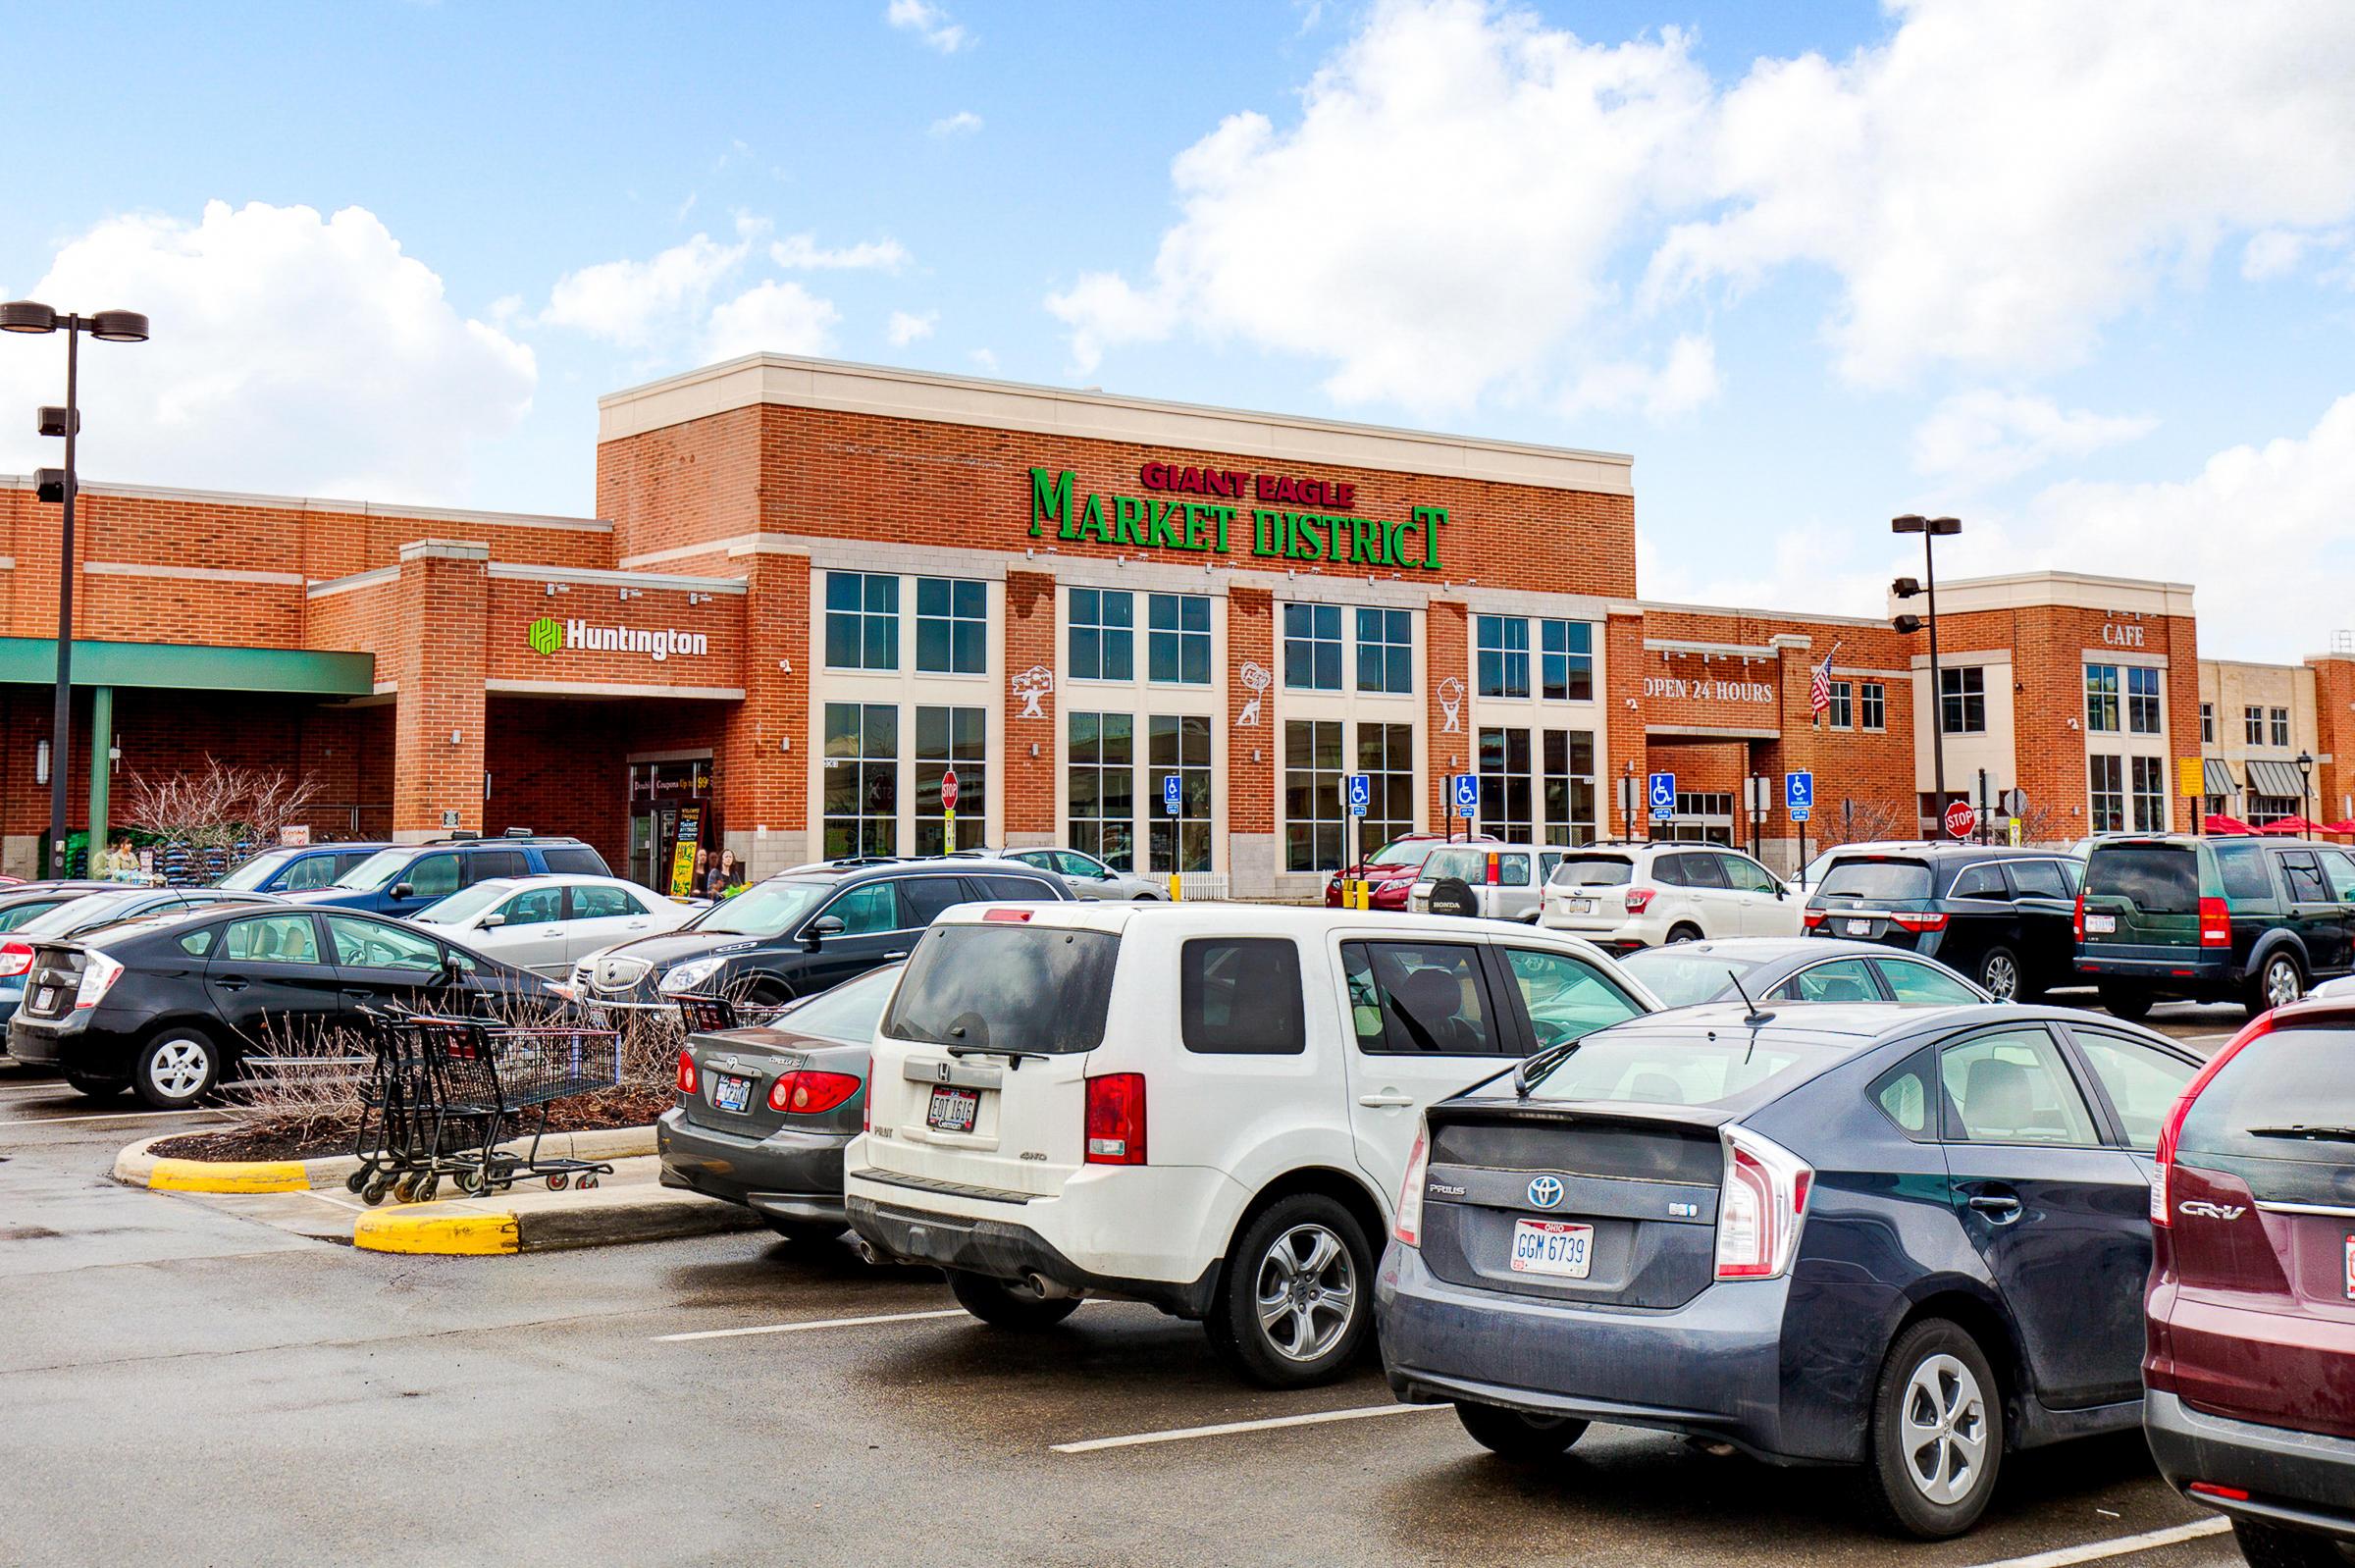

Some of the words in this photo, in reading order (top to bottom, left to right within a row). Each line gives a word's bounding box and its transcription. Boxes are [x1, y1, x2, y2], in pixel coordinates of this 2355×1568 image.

[1140, 461, 1250, 497] GIANT
[1256, 474, 1356, 508] EAGLE
[1028, 466, 1237, 552] MARKET
[1252, 505, 1449, 568] DISTRICT
[566, 619, 707, 661] Huntington
[2103, 623, 2145, 647] CAFE
[1643, 677, 1687, 698] OPEN
[1692, 679, 1711, 700] 24
[1715, 680, 1773, 704] HOURS
[942, 783, 957, 798] STOP
[1947, 810, 1973, 829] STOP
[1433, 901, 1461, 910] HONDA
[950, 1099, 973, 1122] 1616
[874, 1125, 893, 1138] PILOT
[1020, 1151, 1047, 1162] 4WD
[1429, 1183, 1466, 1196] PRIUS
[2178, 1200, 2247, 1221] CR-V
[1544, 1224, 1564, 1233] OHIO
[1518, 1233, 1545, 1259] GGM
[1548, 1236, 1585, 1264] 6739
